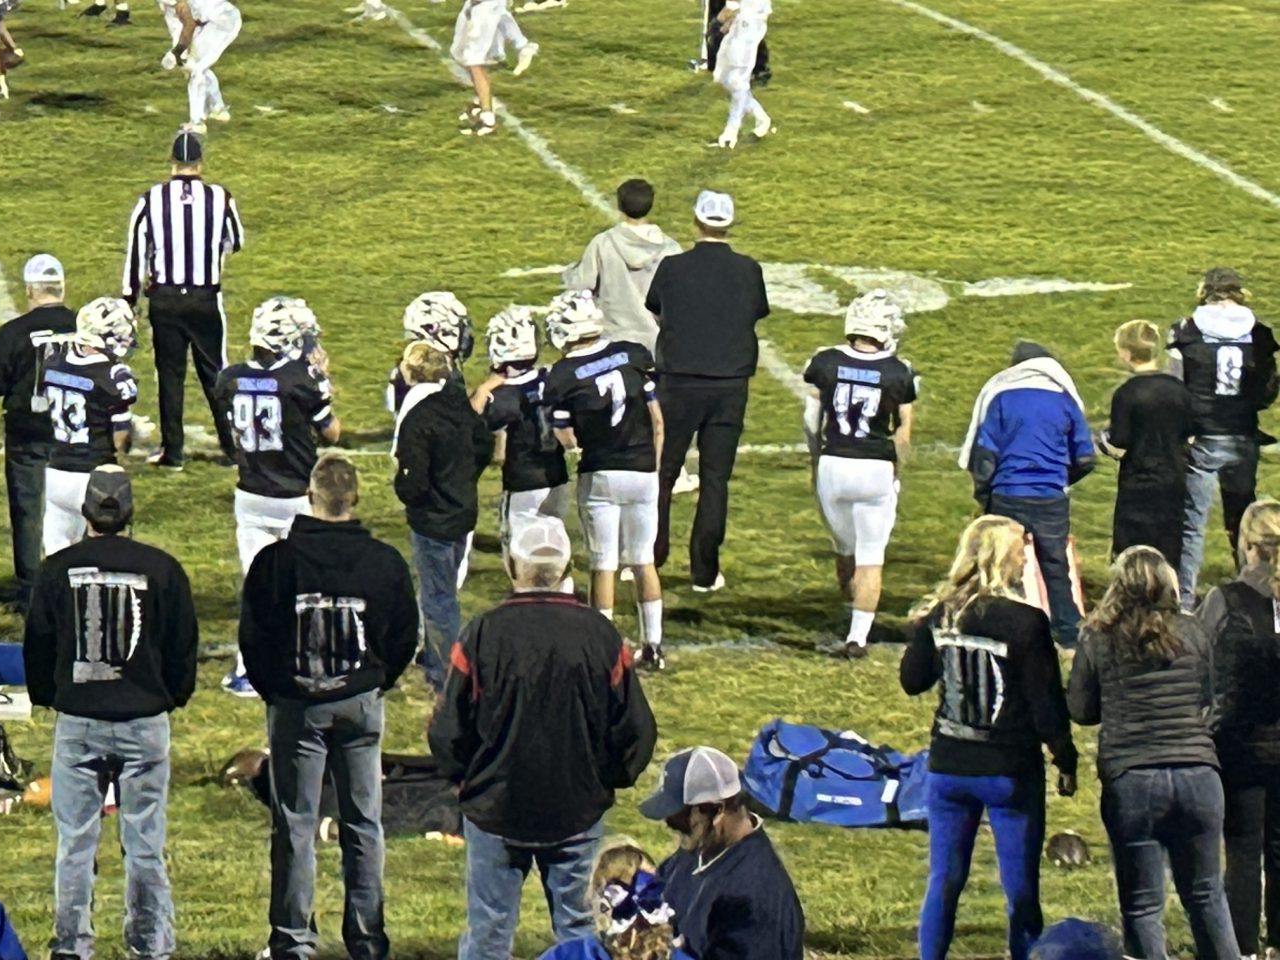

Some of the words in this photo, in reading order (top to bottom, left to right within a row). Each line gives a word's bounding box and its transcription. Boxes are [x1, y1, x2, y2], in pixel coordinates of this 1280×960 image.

[232, 393, 283, 453] 93
[594, 369, 627, 428] 7
[832, 381, 883, 438] 17
